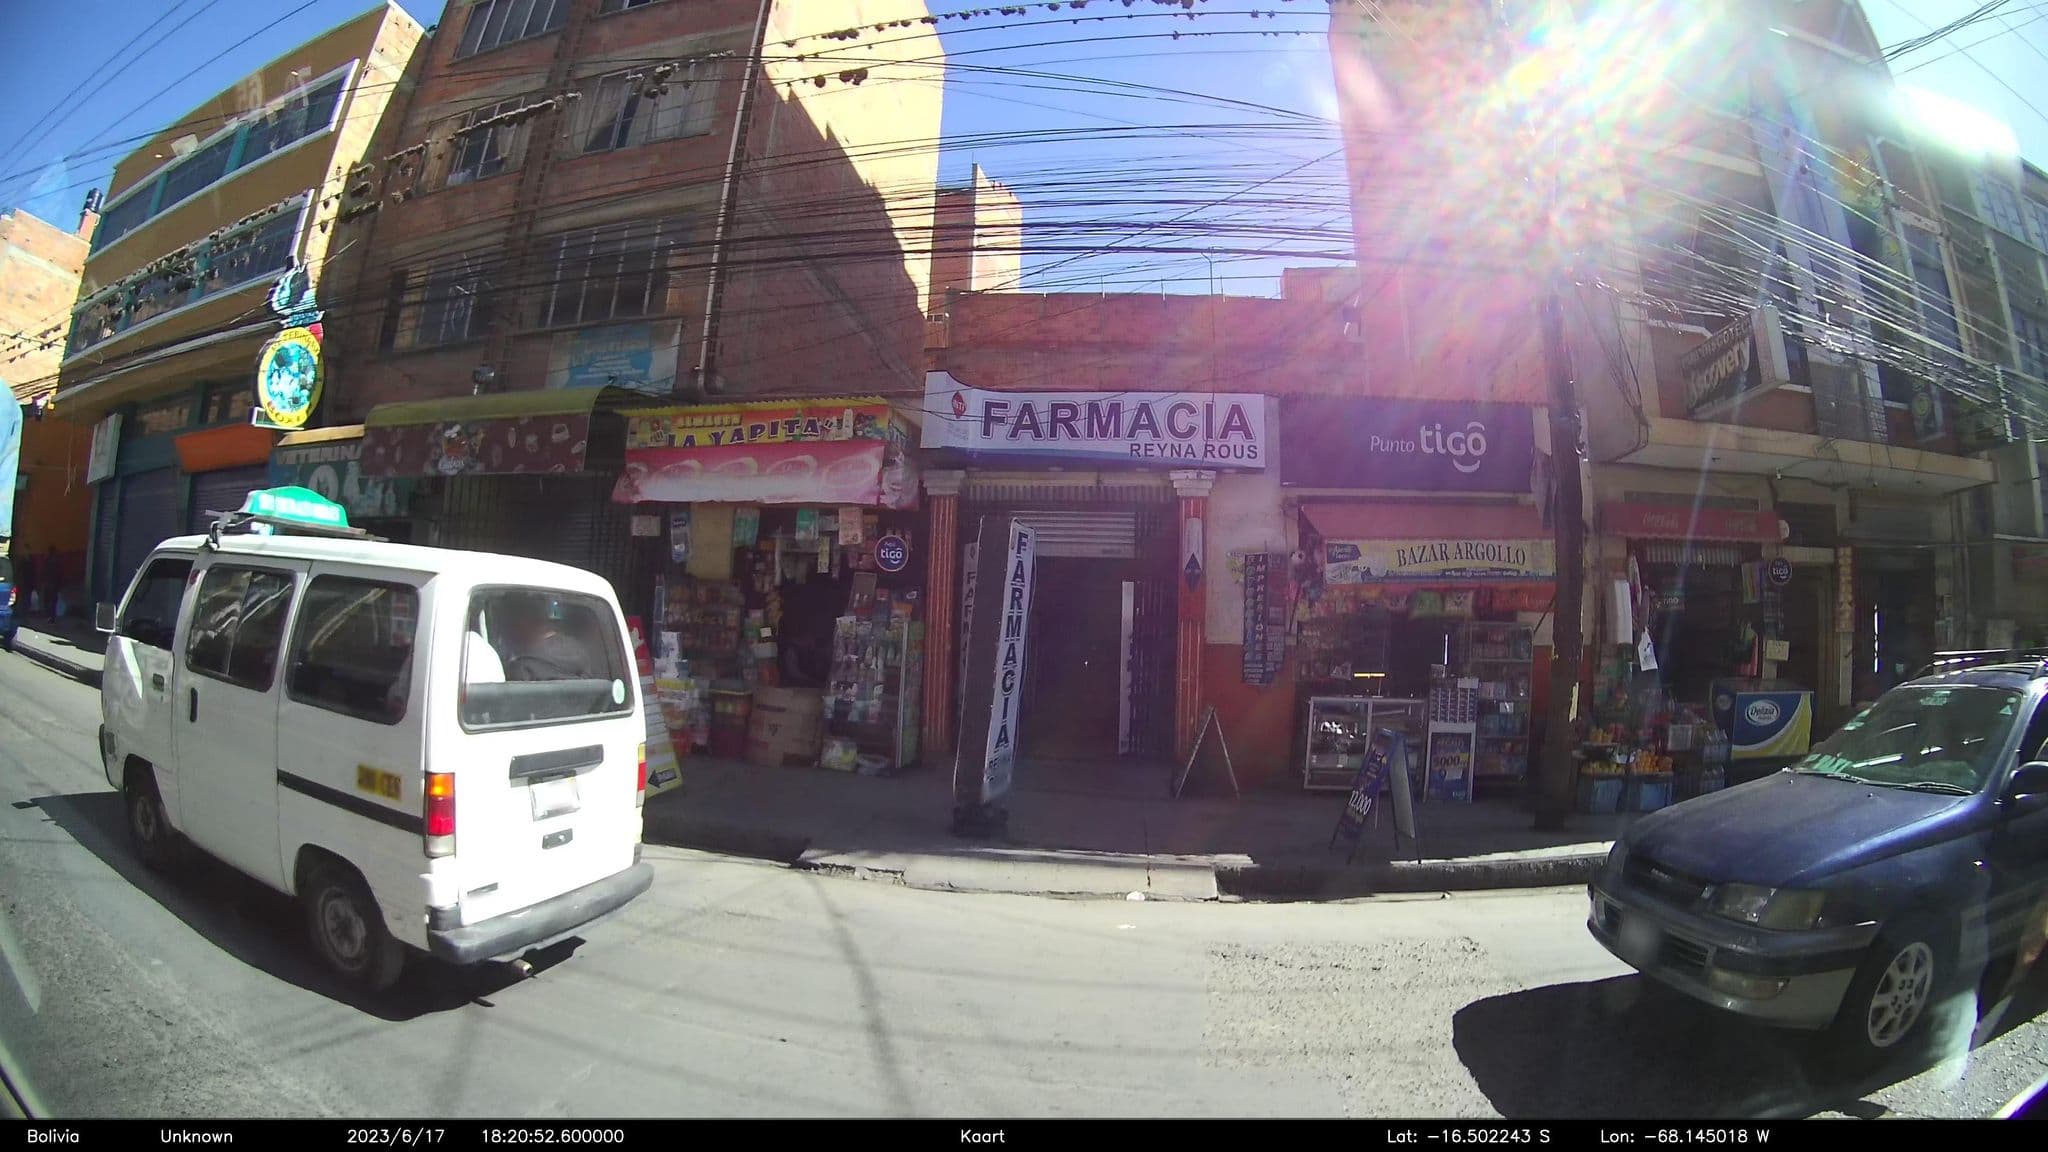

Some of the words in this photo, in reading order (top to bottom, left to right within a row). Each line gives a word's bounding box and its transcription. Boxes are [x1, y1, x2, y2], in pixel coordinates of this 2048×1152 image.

[710, 416, 821, 446] YAPITA
[981, 400, 1255, 442] FARMACIA
[1130, 443, 1197, 459] REYNA
[1205, 444, 1259, 460] ROUS
[1370, 435, 1415, 453] Punto
[1397, 546, 1448, 568] BAZAR
[1453, 542, 1526, 566] ARGOLLO
[996, 532, 1030, 750] FARMACIA
